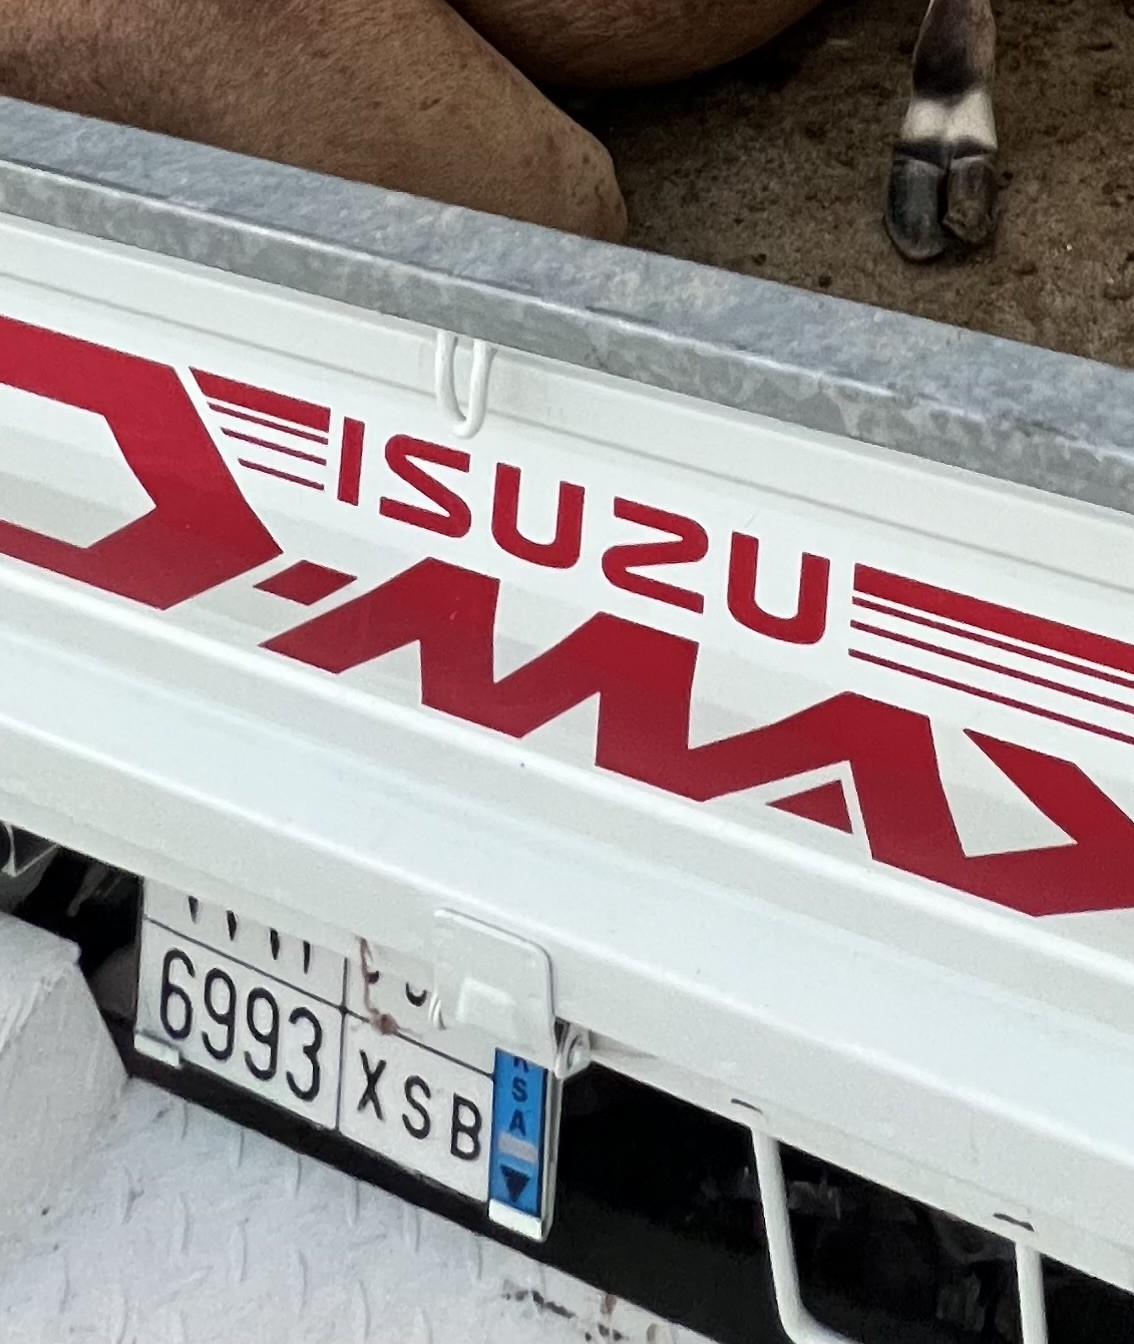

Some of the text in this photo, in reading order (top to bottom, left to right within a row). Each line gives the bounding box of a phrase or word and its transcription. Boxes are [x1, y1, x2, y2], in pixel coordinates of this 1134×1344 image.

[337, 416, 831, 645] ISUZU
[159, 947, 324, 1102] 6993
[357, 1049, 484, 1161] XSB
